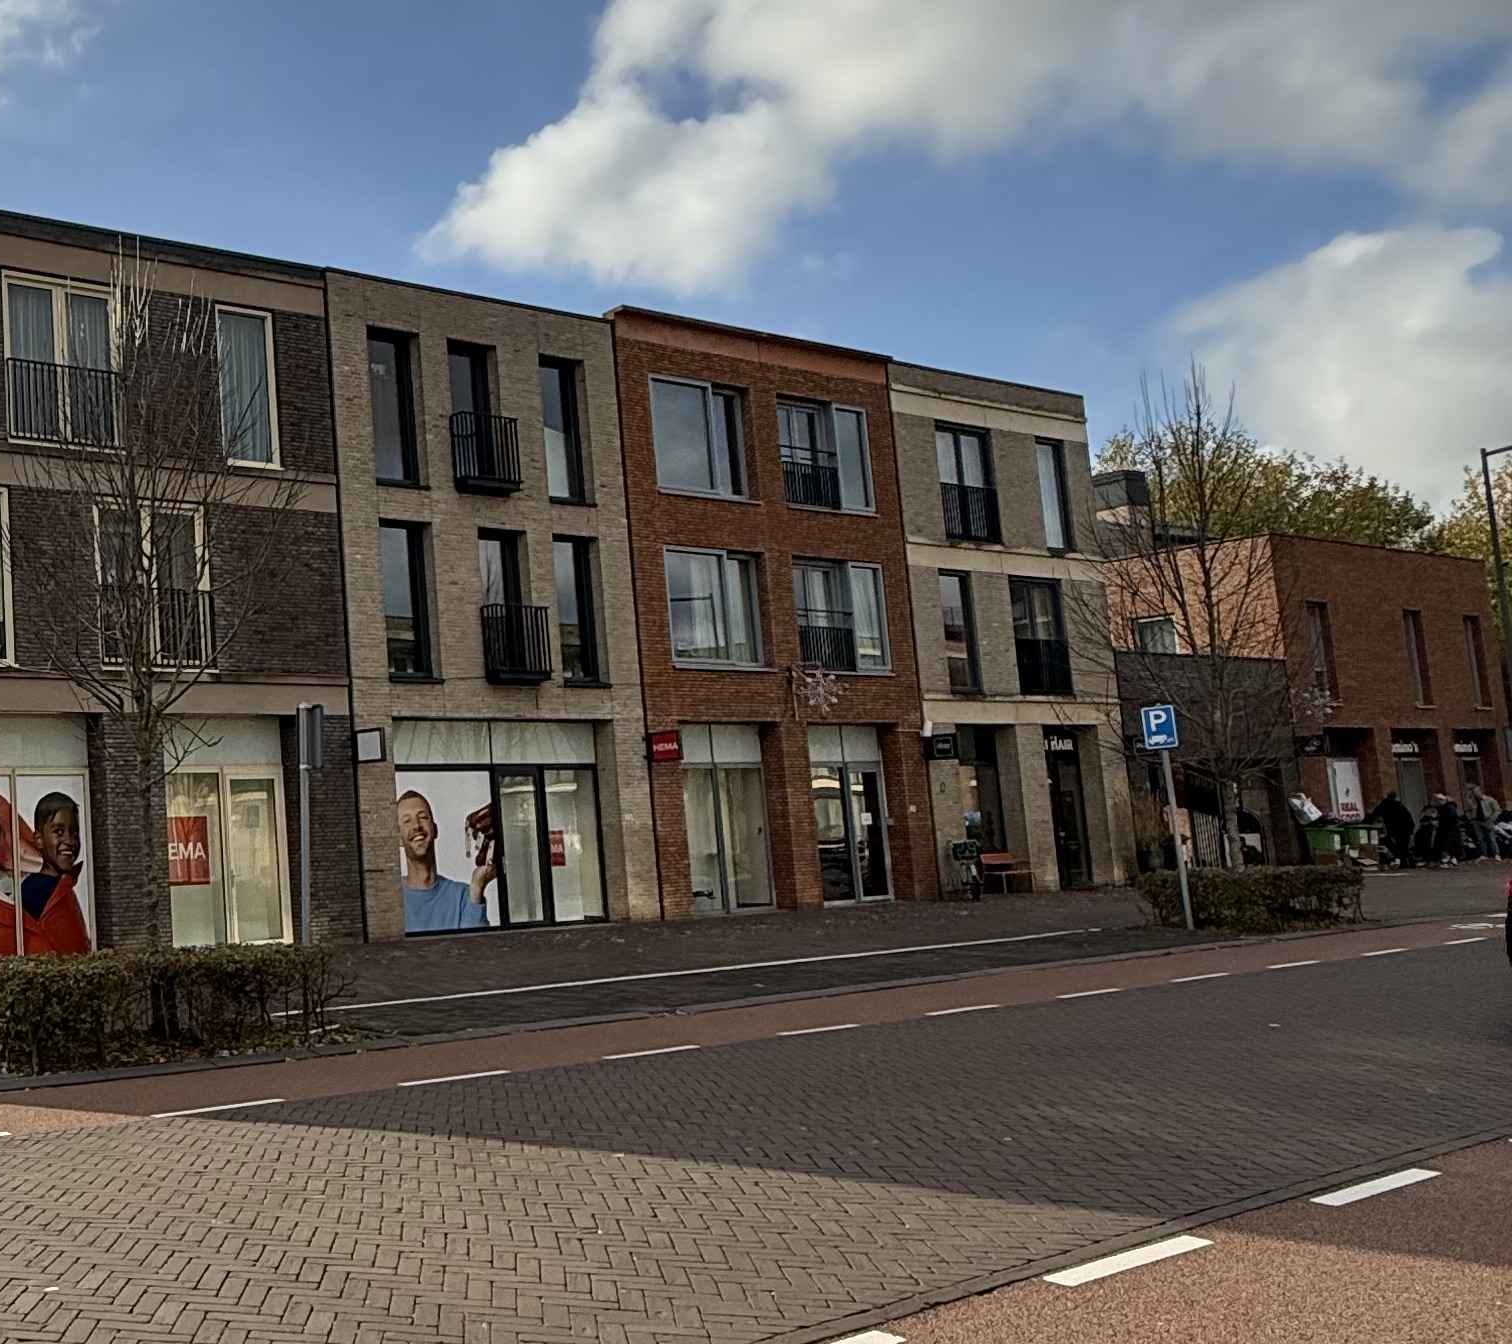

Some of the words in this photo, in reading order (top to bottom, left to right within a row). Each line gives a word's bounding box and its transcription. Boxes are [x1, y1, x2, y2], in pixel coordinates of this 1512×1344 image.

[1148, 710, 1167, 732] P
[652, 742, 679, 752] HEMA
[1050, 736, 1074, 751] HAIR
[168, 842, 206, 861] EMA
